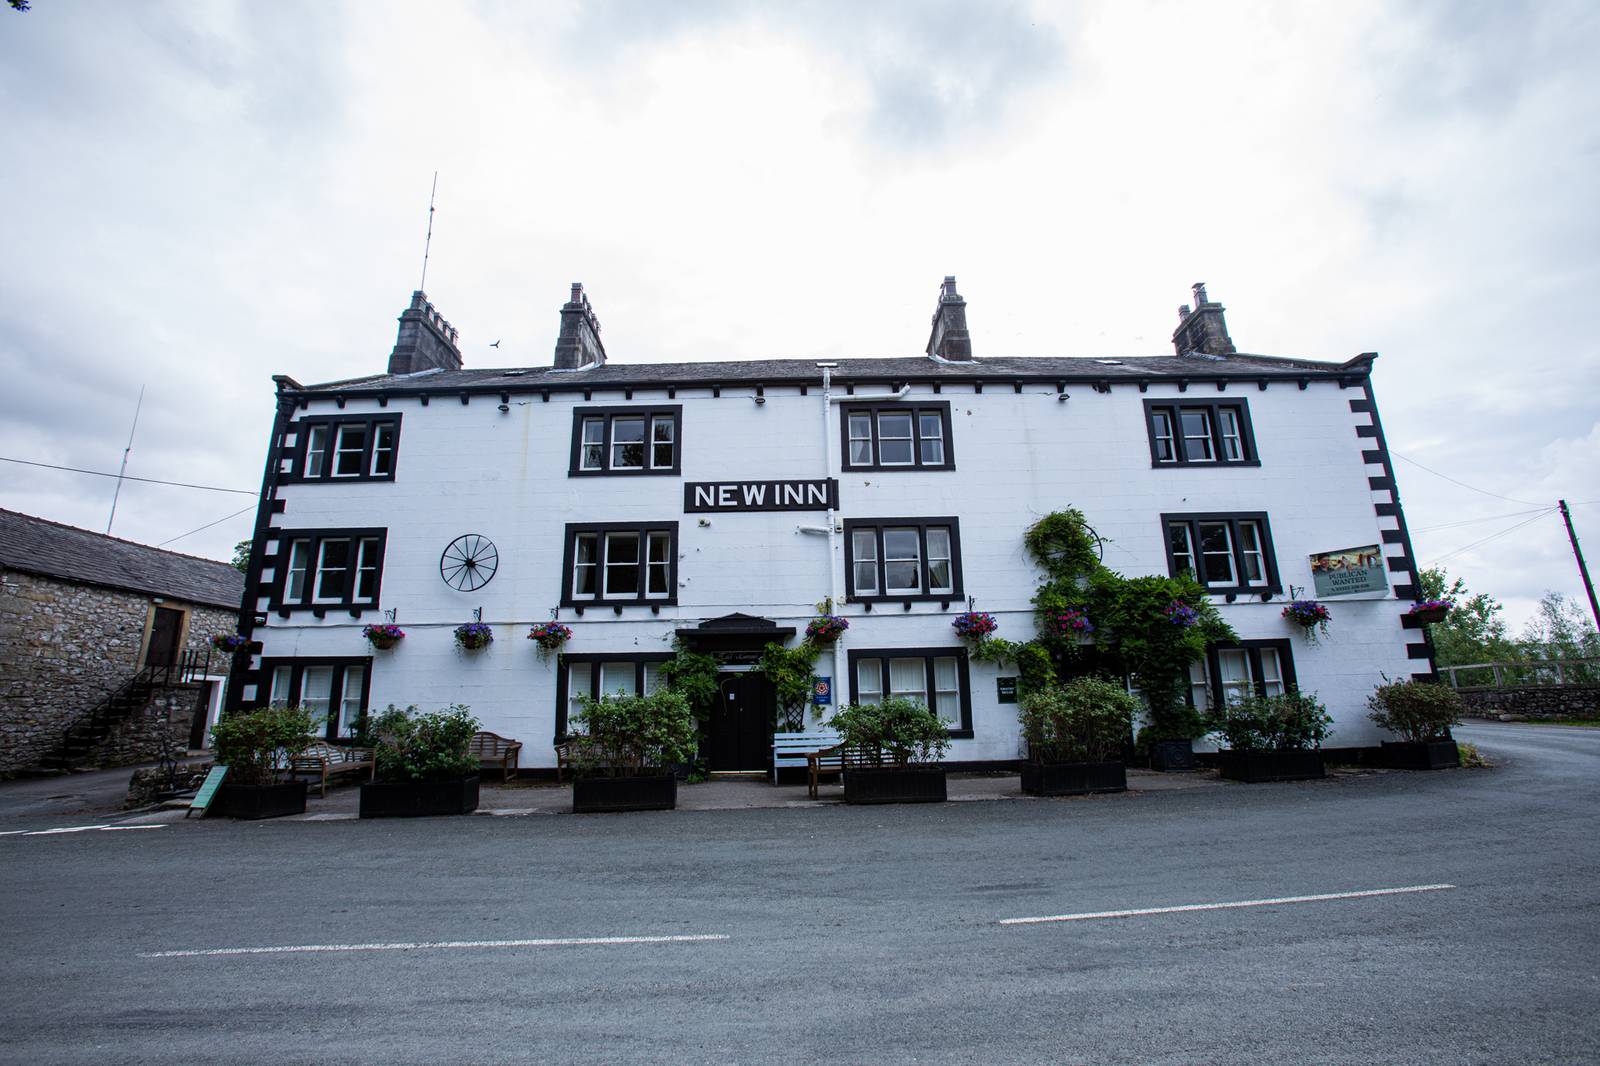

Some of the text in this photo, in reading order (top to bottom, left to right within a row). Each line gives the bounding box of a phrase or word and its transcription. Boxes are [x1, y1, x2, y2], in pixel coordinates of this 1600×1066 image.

[695, 483, 828, 507] NEW INN
[1329, 569, 1368, 580] PUBLICAN
[1332, 576, 1367, 585] WANTED
